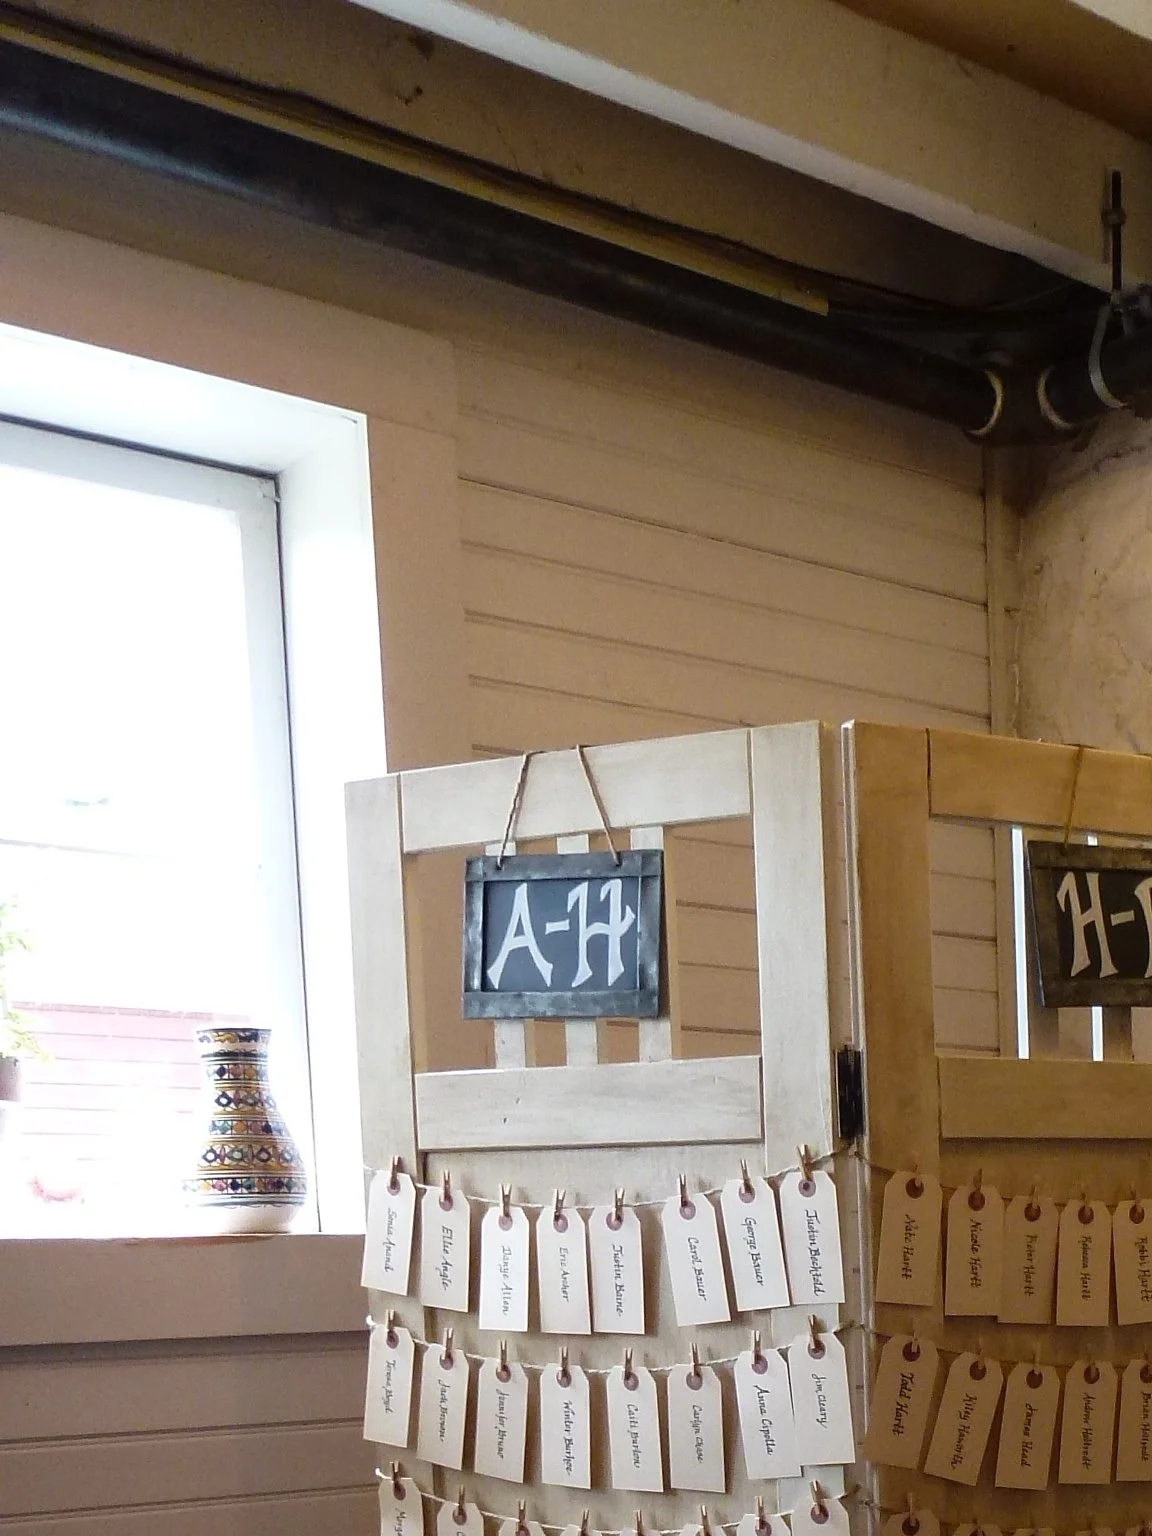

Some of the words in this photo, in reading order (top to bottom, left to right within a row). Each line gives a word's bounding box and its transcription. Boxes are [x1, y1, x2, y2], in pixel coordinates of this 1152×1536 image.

[487, 879, 635, 989] A-H
[384, 1207, 397, 1237] Sonia
[742, 1216, 757, 1251] George
[805, 1208, 821, 1247] Justin
[969, 1217, 984, 1255] Nicole
[382, 1237, 396, 1273] Anand
[441, 1225, 454, 1255] Ellie
[559, 1246, 568, 1267] Eric
[687, 1237, 702, 1265] Carol
[437, 1255, 453, 1291] Angle
[612, 1244, 624, 1281] Justin
[748, 1251, 764, 1287] Bauer
[901, 1244, 915, 1280] Hartt
[968, 1256, 983, 1289] Hartt
[502, 1282, 513, 1313] Allen
[561, 1269, 570, 1302] Archer
[614, 1282, 625, 1314] Baine
[692, 1266, 707, 1302] Bauer
[1023, 1264, 1037, 1297] Hartt
[1079, 1271, 1092, 1302] Hartt
[754, 1384, 770, 1417] Anna
[811, 1373, 827, 1394] Jim
[898, 1371, 915, 1401] Todd
[494, 1388, 510, 1429] Jennifer
[563, 1400, 576, 1433] Winter
[816, 1394, 828, 1429] Cleary
[892, 1400, 909, 1437] Hartt
[1022, 1402, 1039, 1438] James
[627, 1429, 642, 1469] Burton
[694, 1436, 704, 1461] Chase
[760, 1418, 776, 1456] Cipolla
